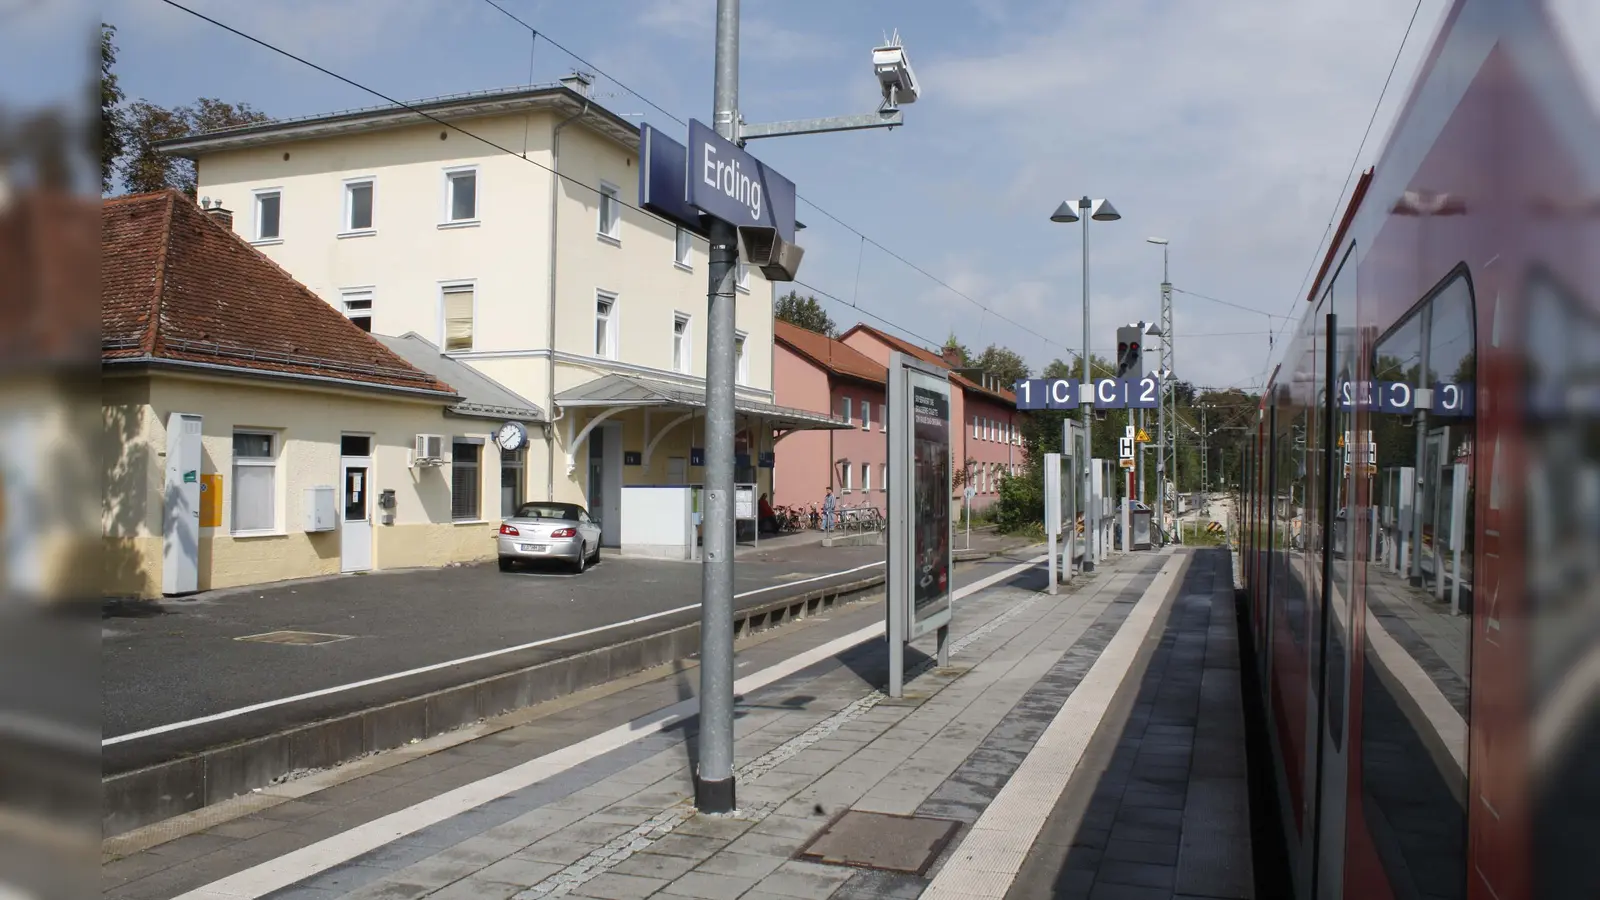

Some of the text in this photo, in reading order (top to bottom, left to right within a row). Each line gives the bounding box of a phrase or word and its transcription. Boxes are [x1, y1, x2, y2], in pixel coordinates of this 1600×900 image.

[704, 142, 761, 220] Erding
[1020, 379, 1070, 403] 1 C
[1098, 378, 1155, 403] C 2
[1121, 438, 1133, 456] H
